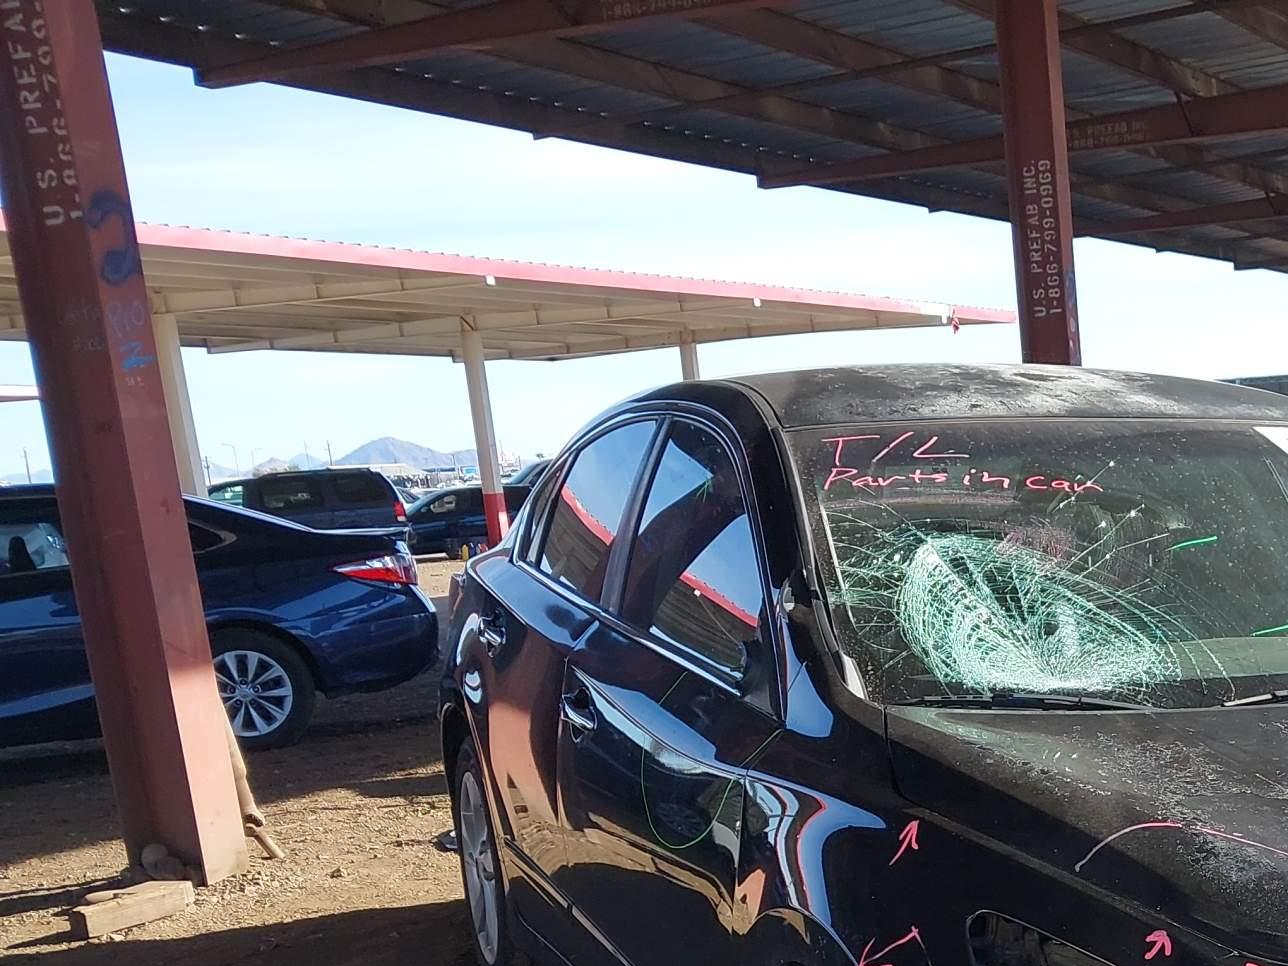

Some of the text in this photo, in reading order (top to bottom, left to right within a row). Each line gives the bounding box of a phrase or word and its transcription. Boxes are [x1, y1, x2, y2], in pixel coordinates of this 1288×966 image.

[1023, 159, 1047, 318] U.S. PREFAB INC.
[824, 468, 1104, 492] Parts in car
